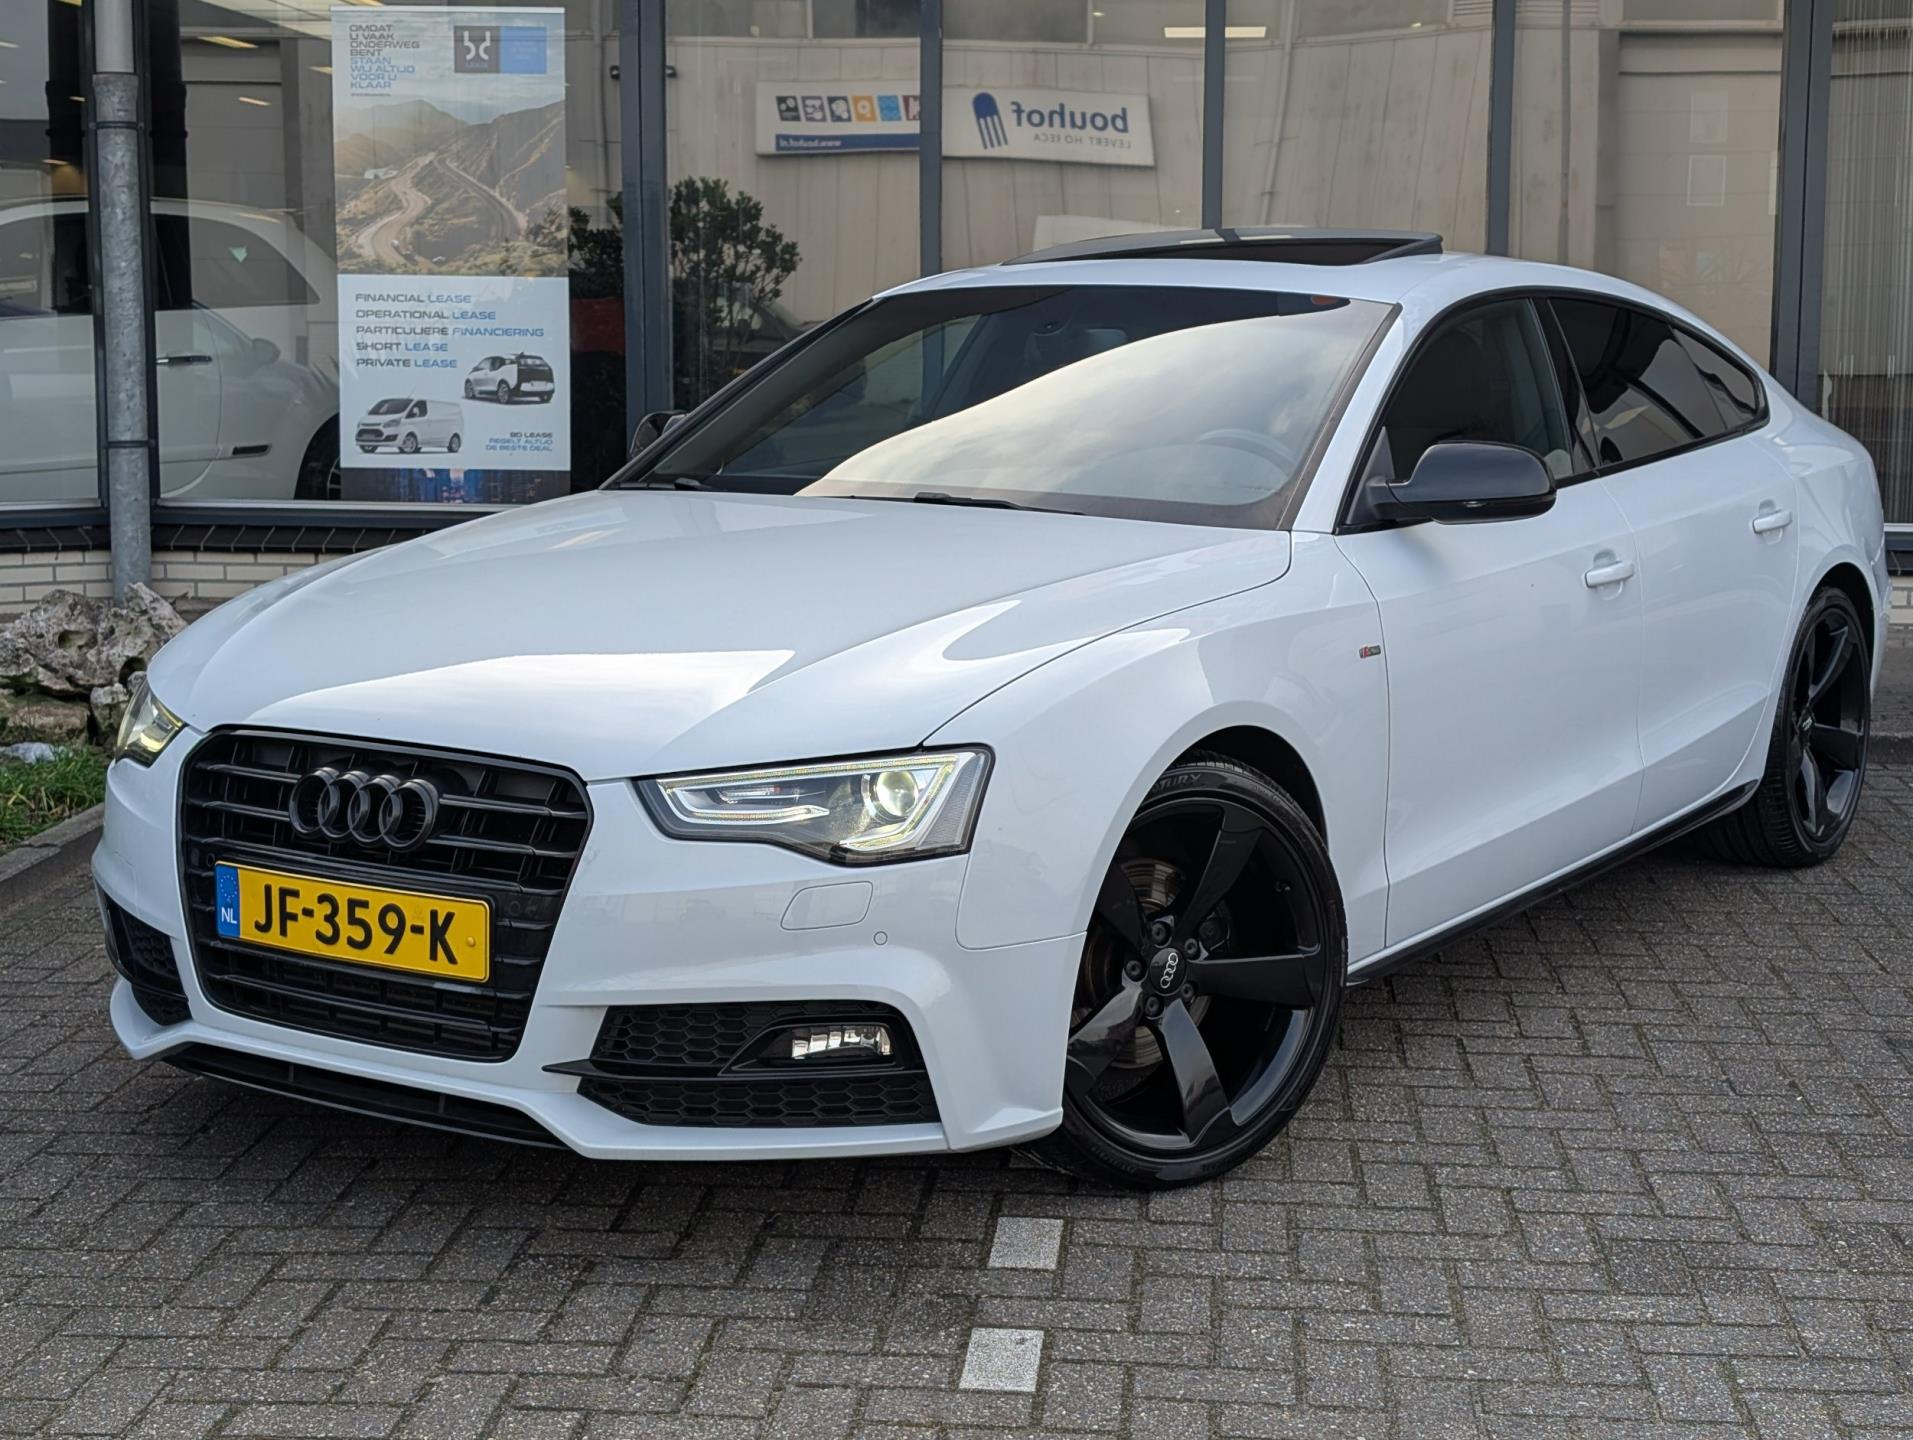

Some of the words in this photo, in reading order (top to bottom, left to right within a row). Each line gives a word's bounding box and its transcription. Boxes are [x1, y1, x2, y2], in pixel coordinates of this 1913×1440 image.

[349, 24, 392, 32] OMDAT
[350, 40, 420, 48] ONDERWEG
[350, 48, 383, 56] BENT
[350, 56, 391, 64] STAAN
[351, 80, 391, 88] KLAAR
[355, 293, 425, 303] FINANCIAL
[427, 294, 472, 303] LEASE
[355, 309, 449, 319] OPERATIONAL
[452, 311, 497, 320] LEASE
[356, 326, 449, 336] PARTICULIERE
[452, 327, 545, 337] FINANCIERING
[356, 342, 402, 352] SHORT
[405, 343, 449, 352] LEASE
[356, 358, 411, 368] PRIVATE
[414, 359, 458, 368] LEASE
[221, 907, 238, 925] NL
[254, 884, 458, 966] JF-359-K
